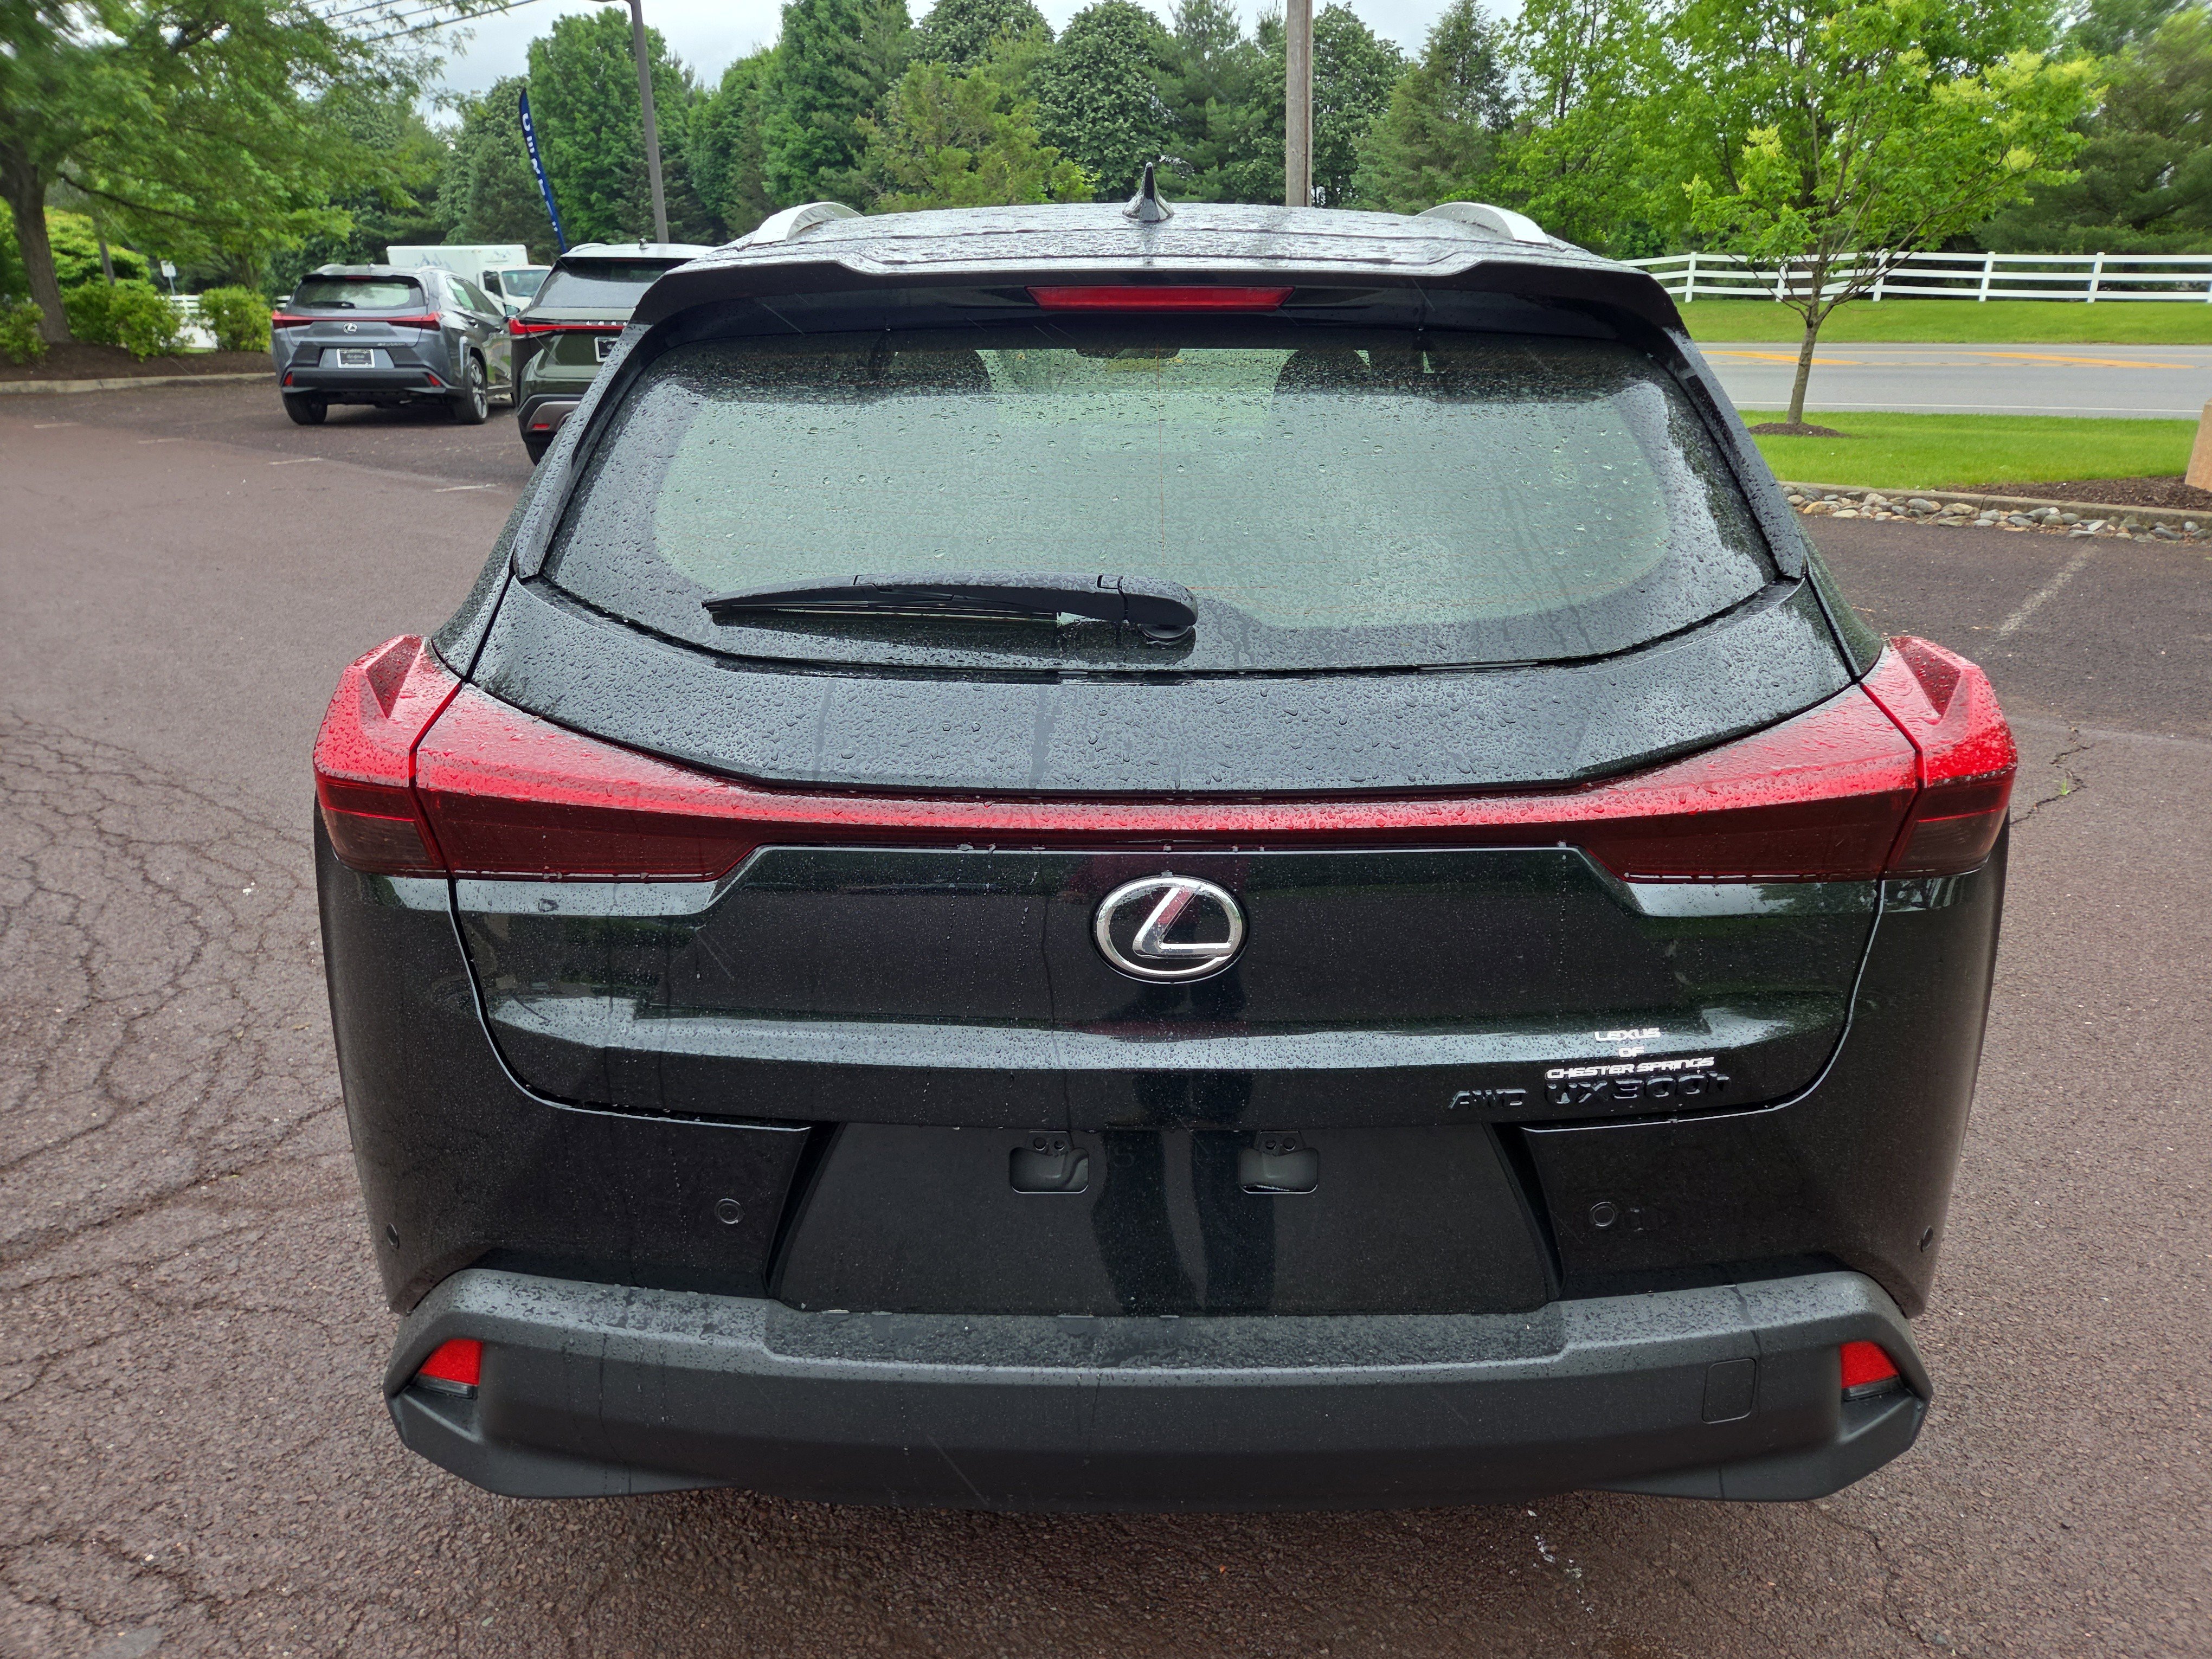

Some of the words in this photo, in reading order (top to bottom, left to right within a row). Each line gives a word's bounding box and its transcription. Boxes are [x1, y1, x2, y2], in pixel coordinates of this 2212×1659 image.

[1594, 1027, 1661, 1041] LEXUS
[1619, 1046, 1645, 1057] OF
[1546, 1063, 1635, 1079] CHESTER
[1637, 1057, 1715, 1073] SPRINGS
[1448, 1088, 1527, 1109] AWD
